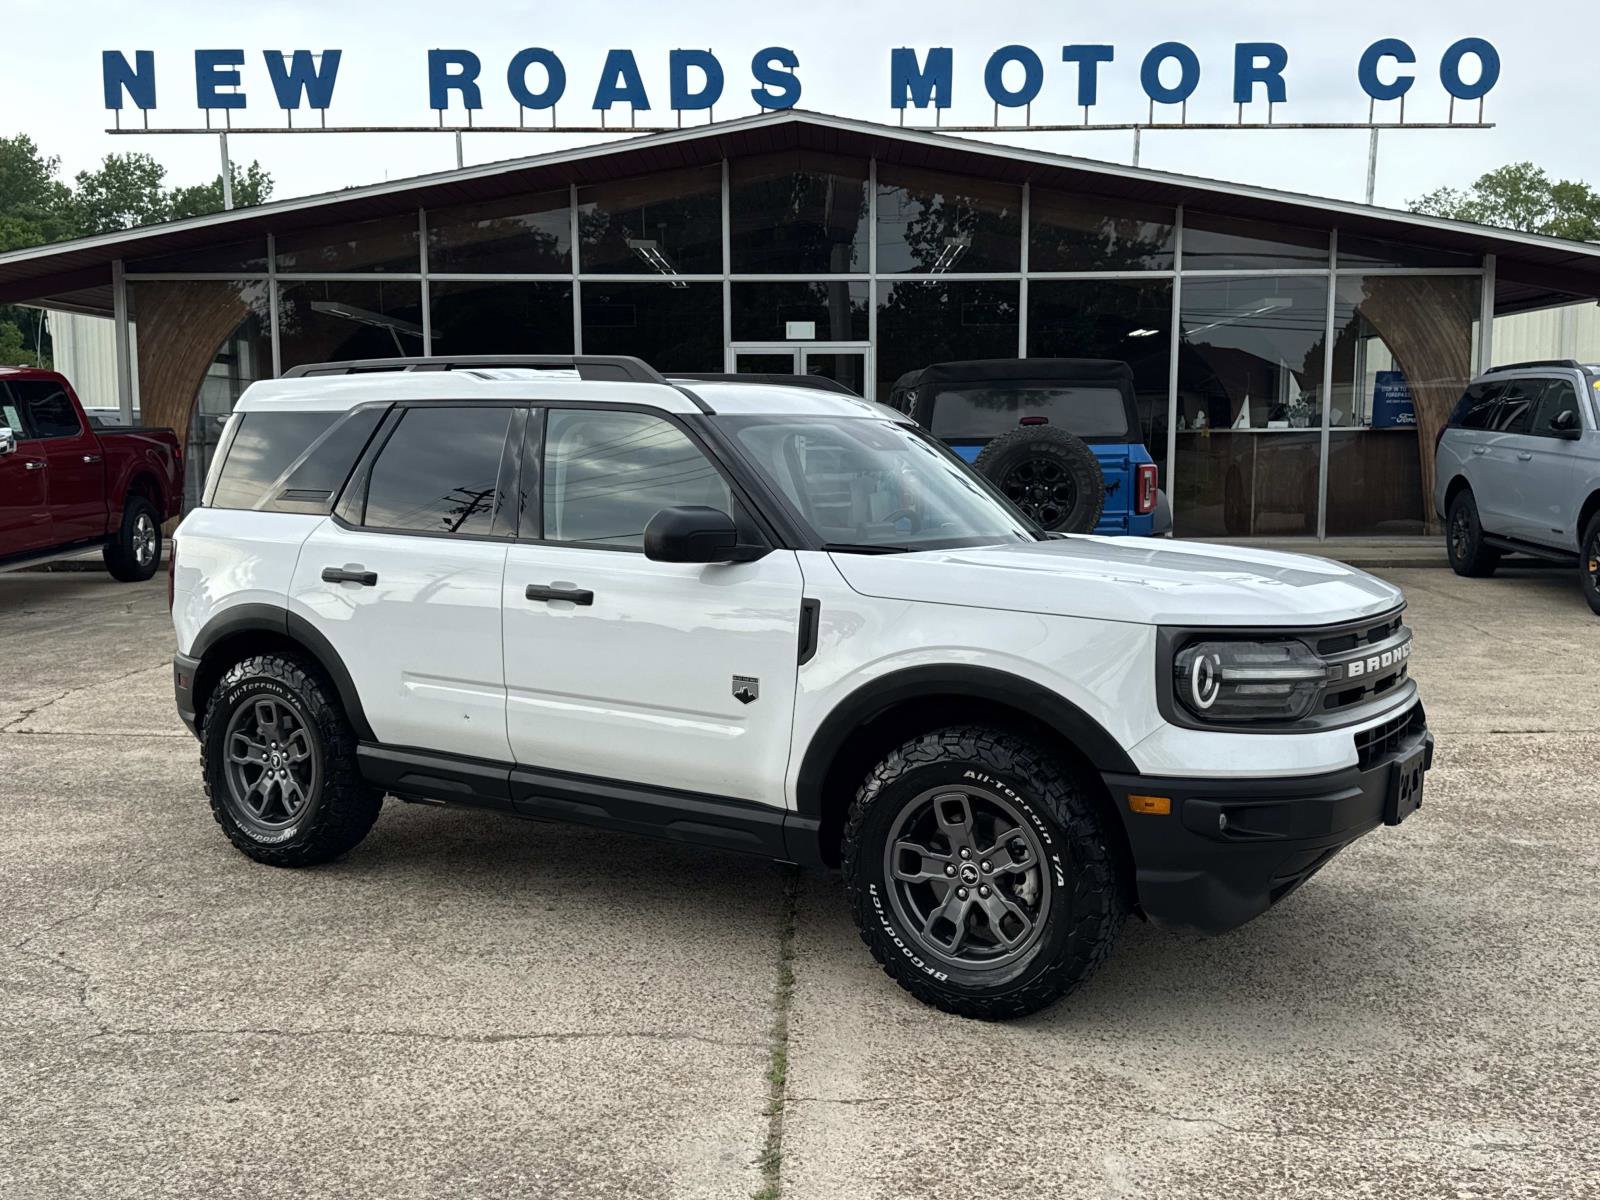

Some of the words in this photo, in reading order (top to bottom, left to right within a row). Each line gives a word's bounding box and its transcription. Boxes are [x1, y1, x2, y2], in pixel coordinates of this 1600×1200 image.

[103, 49, 341, 110] NEW
[428, 47, 802, 111] ROADS
[890, 42, 1287, 110] MOTOR
[1358, 37, 1500, 101] CO
[228, 682, 283, 705] All-Terrain
[963, 769, 1052, 845] All-Terrain
[1052, 853, 1065, 887] T/A
[869, 883, 950, 984] BFGoodrich
